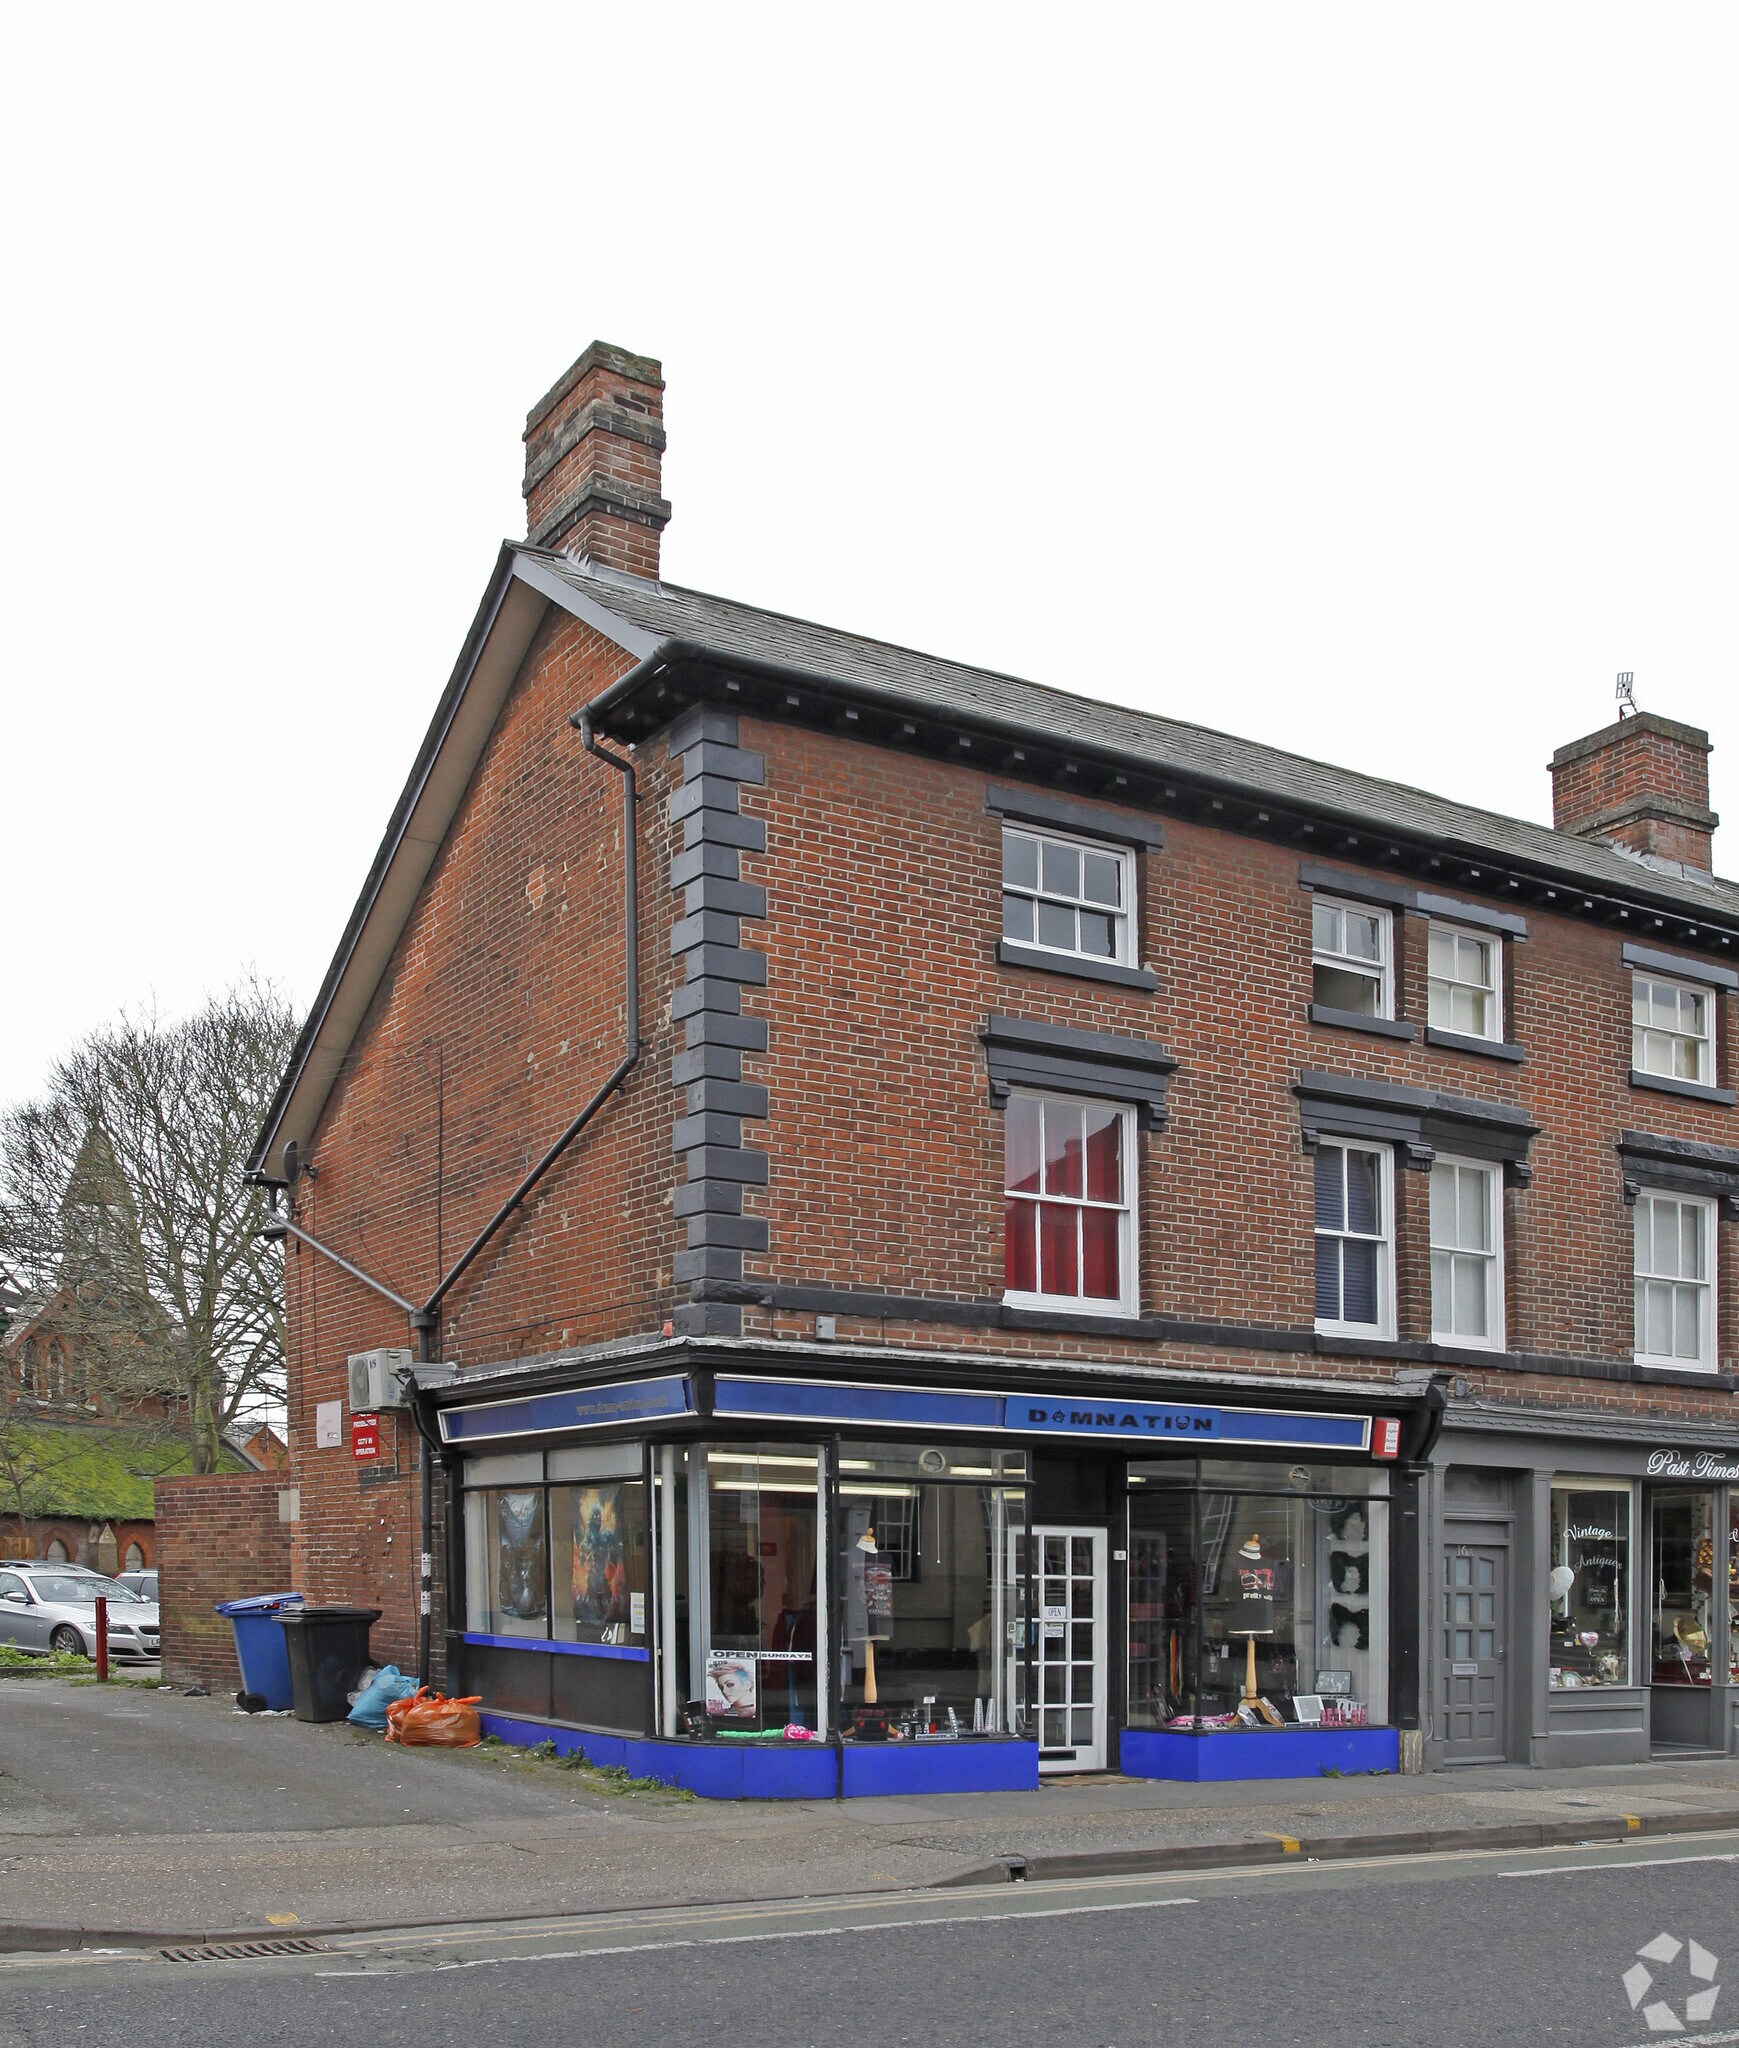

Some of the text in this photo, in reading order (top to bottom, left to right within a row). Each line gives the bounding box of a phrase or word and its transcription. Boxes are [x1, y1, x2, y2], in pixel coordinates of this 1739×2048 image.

[1646, 1449, 1739, 1479] Past Times
[1563, 1524, 1614, 1541] Vintage
[1573, 1554, 1624, 1574] Antiques
[1047, 1607, 1062, 1617] OPEN
